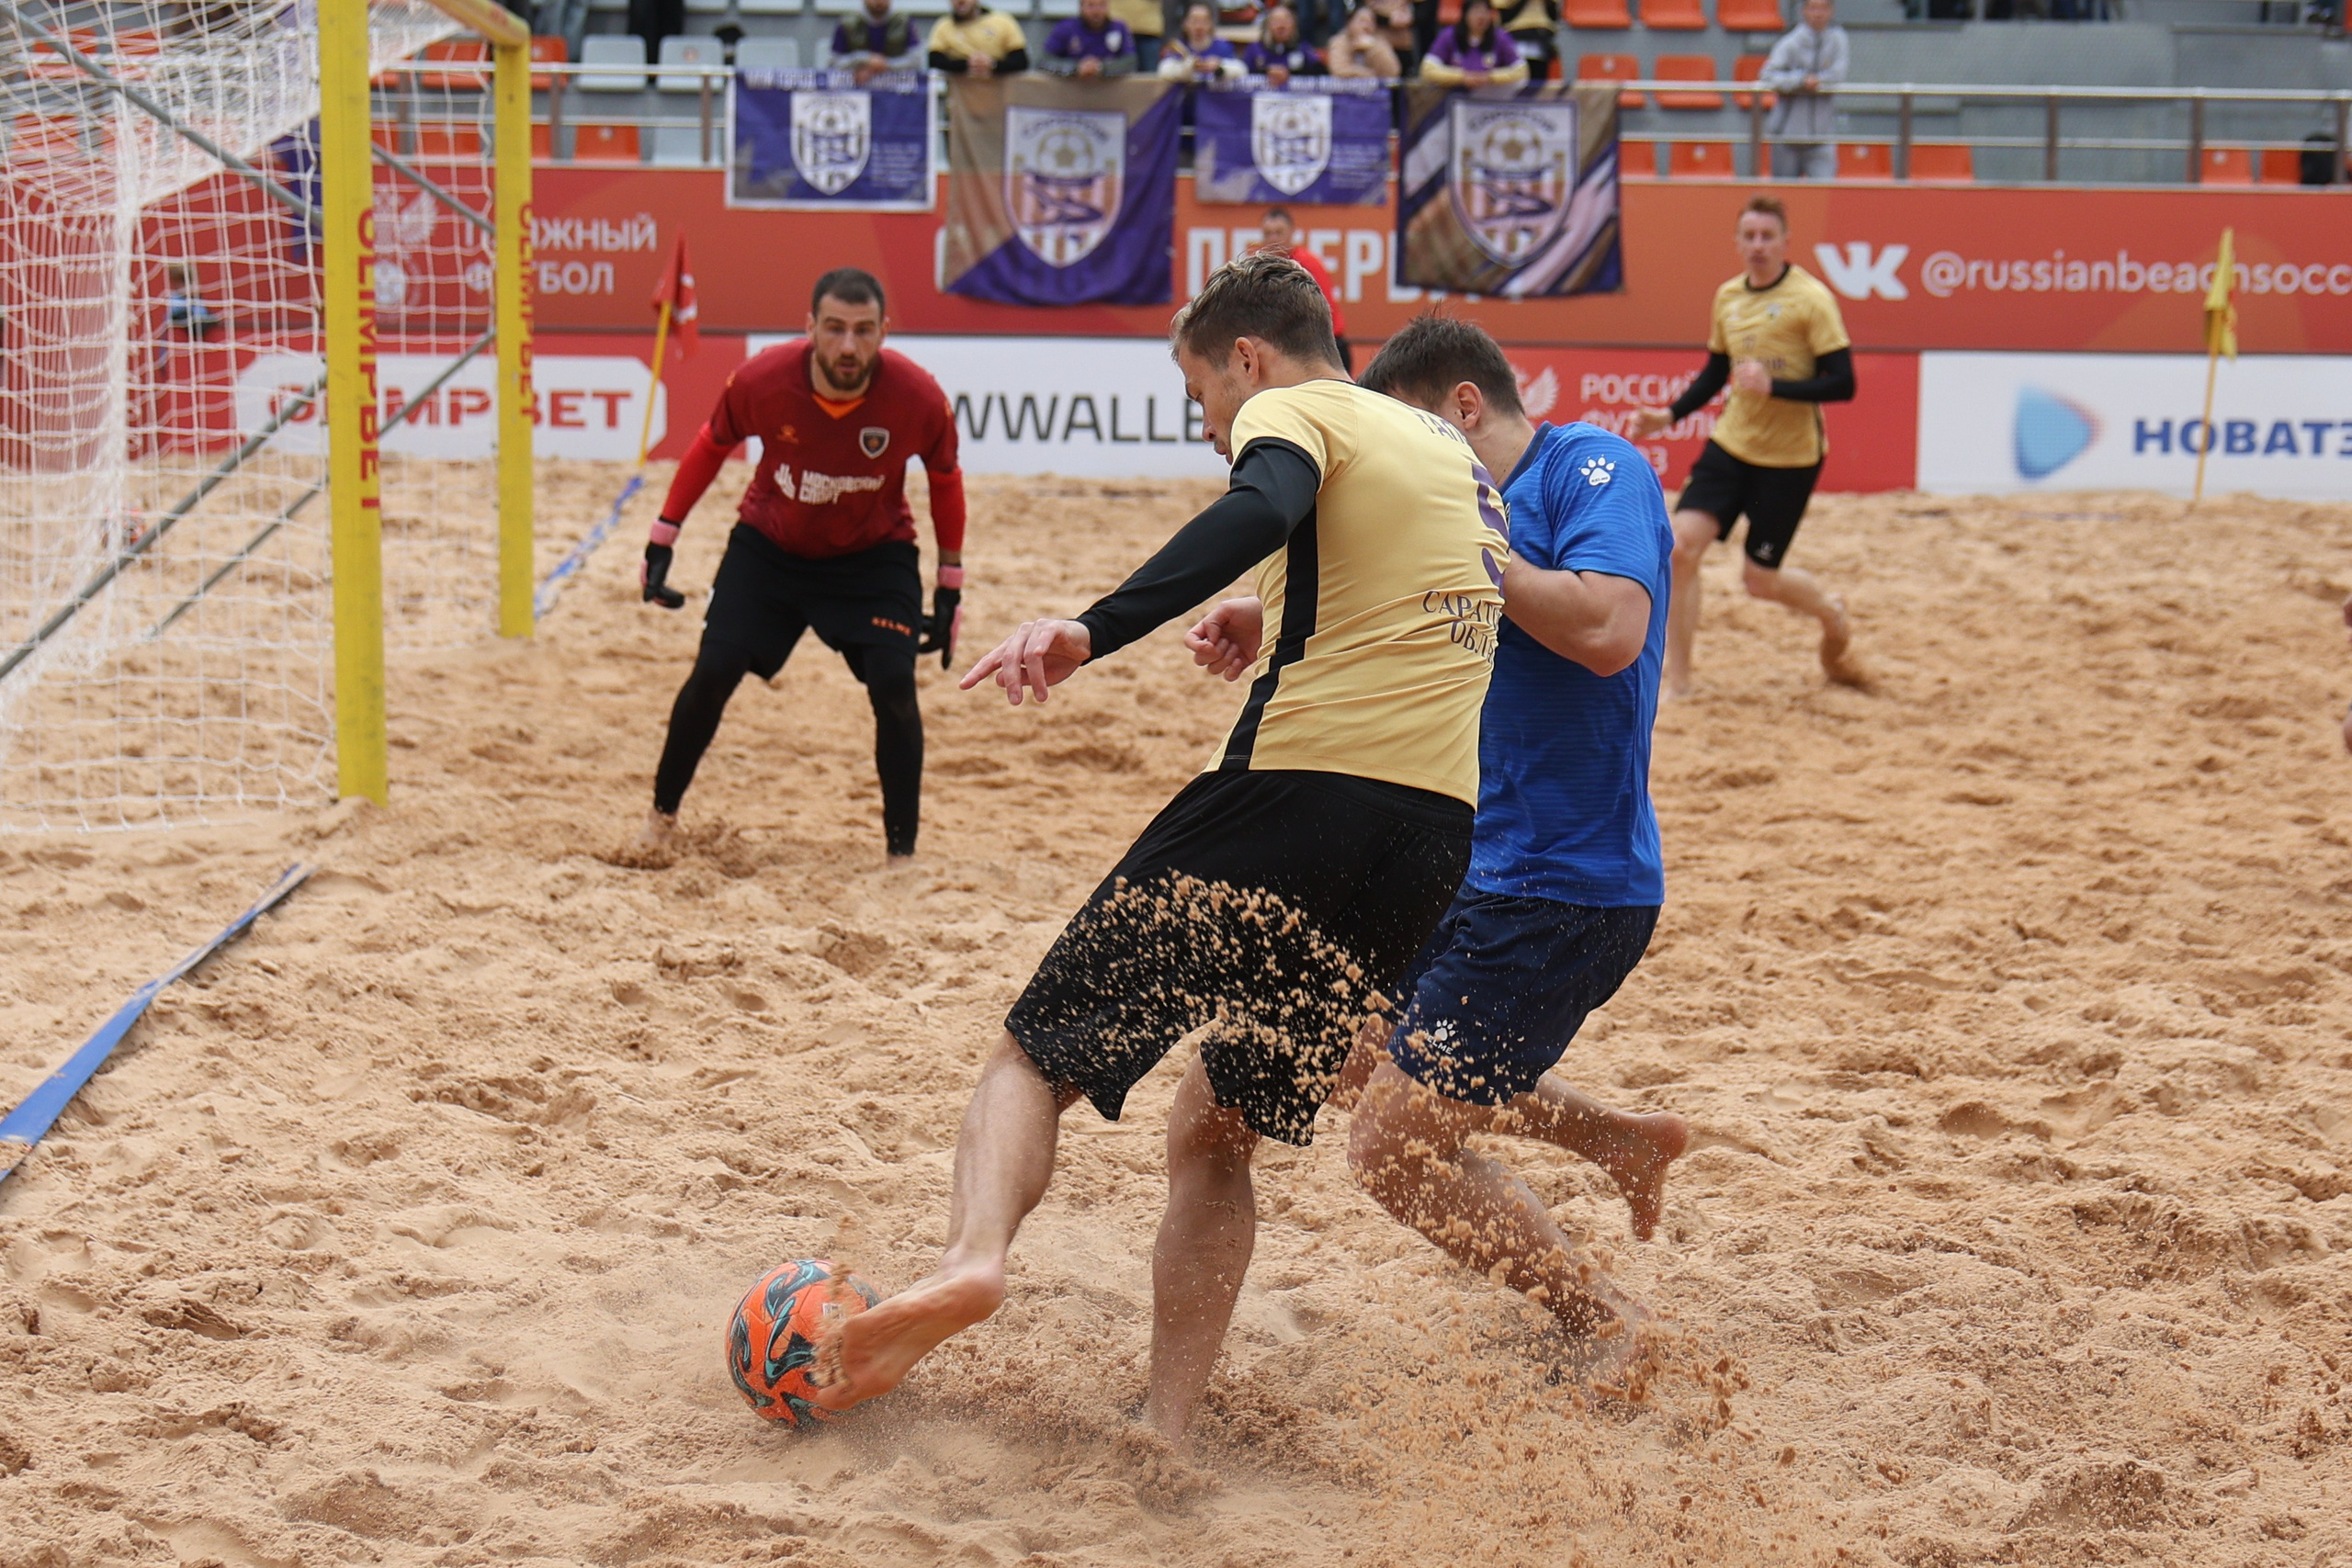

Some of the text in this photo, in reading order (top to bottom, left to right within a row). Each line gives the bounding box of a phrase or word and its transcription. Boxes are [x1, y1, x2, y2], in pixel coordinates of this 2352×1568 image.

[464, 211, 658, 252] ЖНЫЙ
[464, 260, 615, 295] ФБОЛ
[267, 384, 633, 429] OMPET
[1425, 1030, 1453, 1055] ELME
